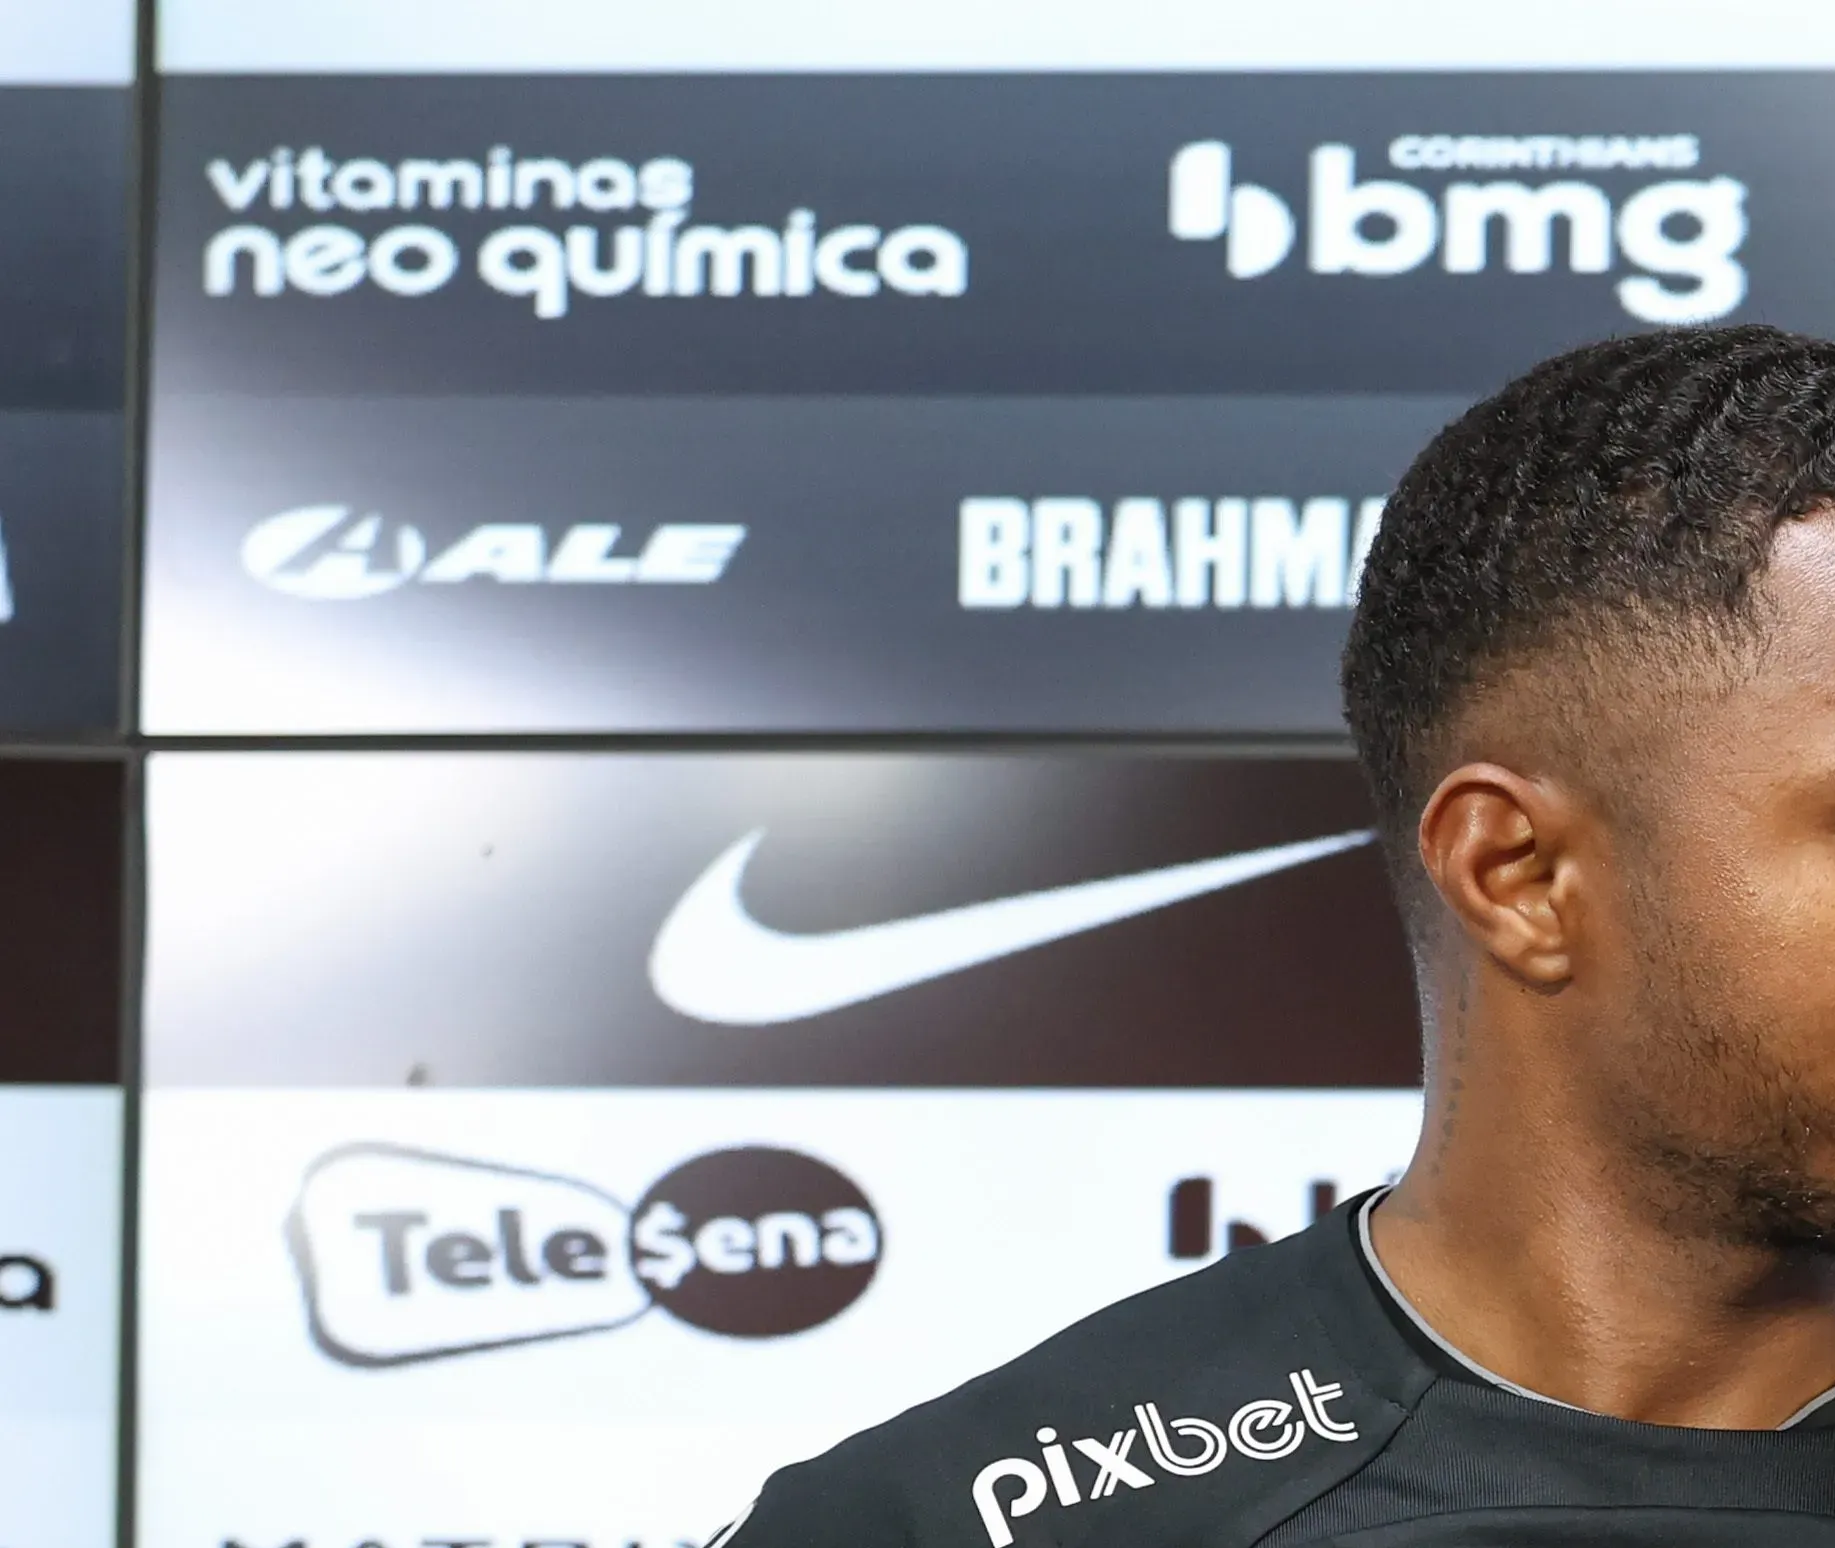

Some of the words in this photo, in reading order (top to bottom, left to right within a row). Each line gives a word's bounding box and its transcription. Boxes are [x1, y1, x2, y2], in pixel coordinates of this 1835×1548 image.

[206, 146, 692, 210] vitaminas
[206, 226, 457, 295] neo
[478, 209, 967, 318] química
[1310, 145, 1747, 322] bmg
[418, 524, 747, 583] ALE
[355, 1209, 606, 1294] Tele
